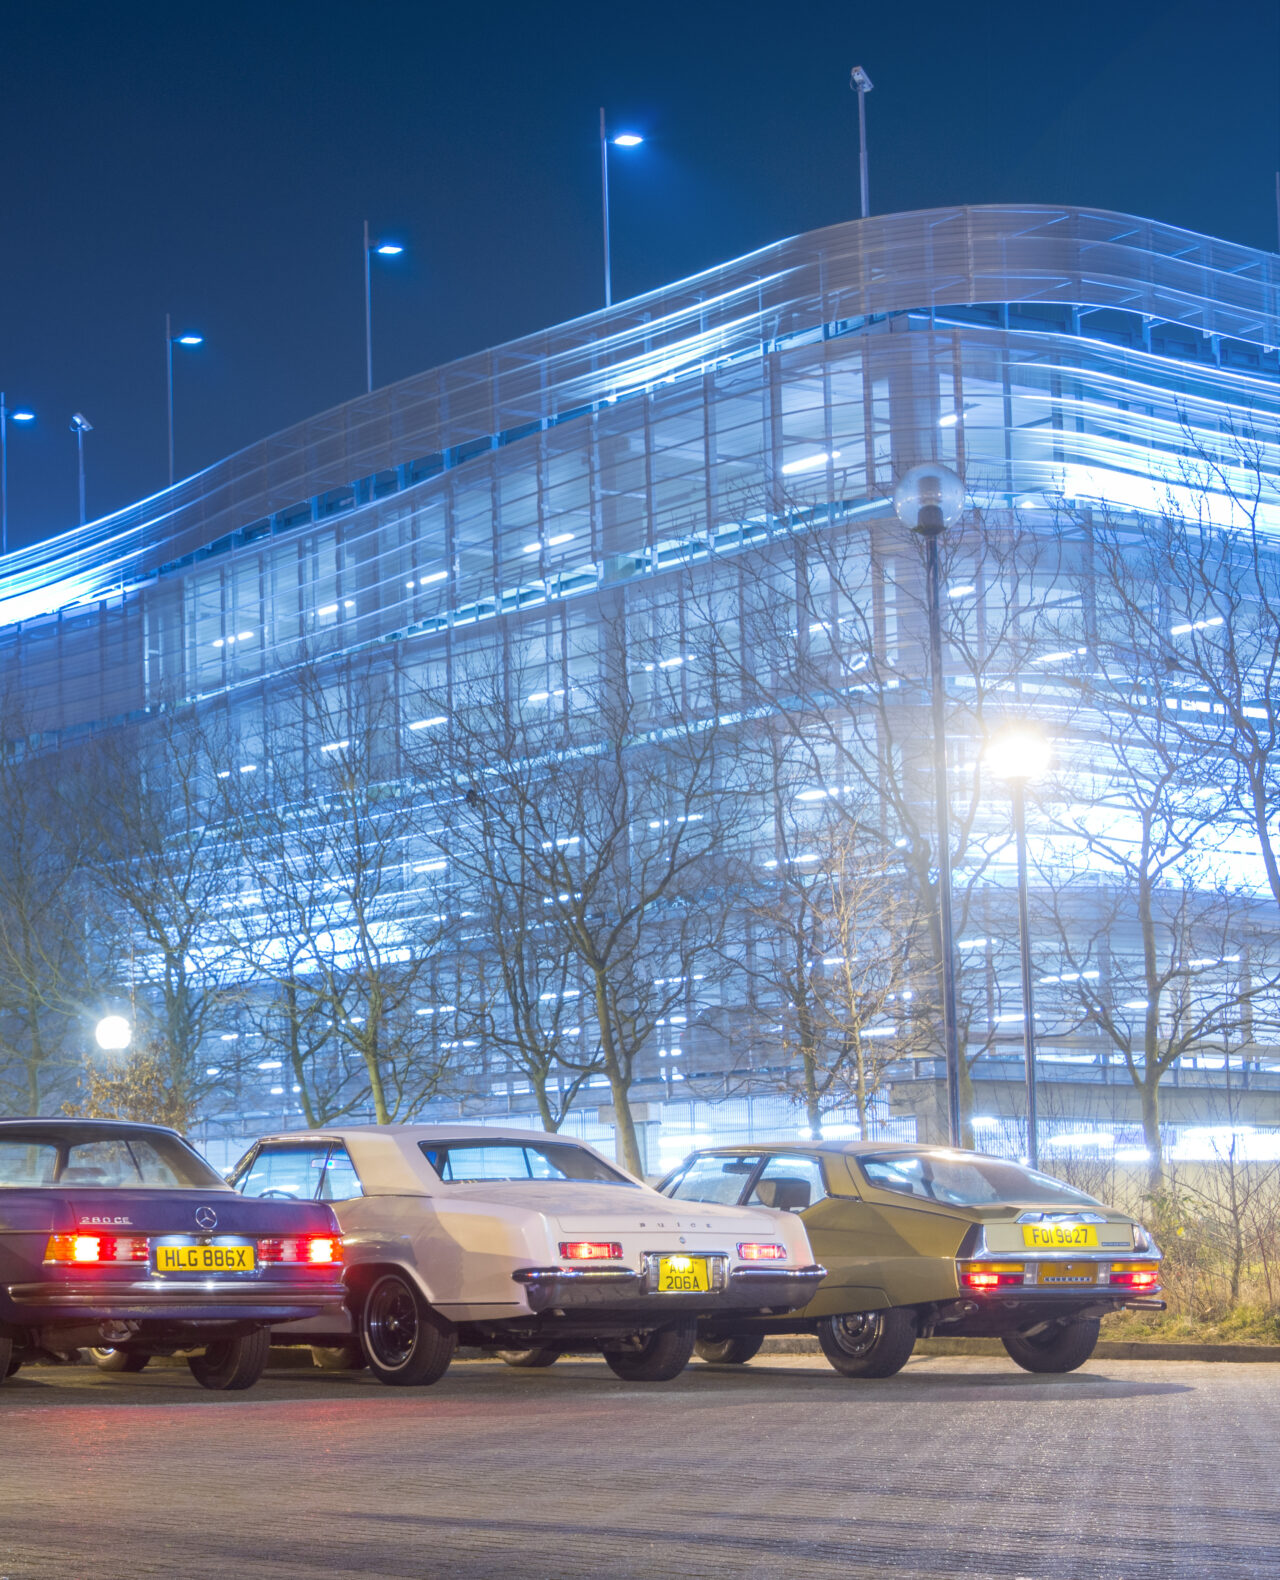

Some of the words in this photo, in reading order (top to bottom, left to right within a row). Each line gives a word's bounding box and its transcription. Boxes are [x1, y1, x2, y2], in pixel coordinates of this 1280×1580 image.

[1032, 1228, 1053, 1244] FOI
[1056, 1228, 1088, 1244] 9827
[165, 1250, 198, 1267] HLG
[203, 1250, 246, 1267] 886X
[666, 1276, 700, 1289] 206A
